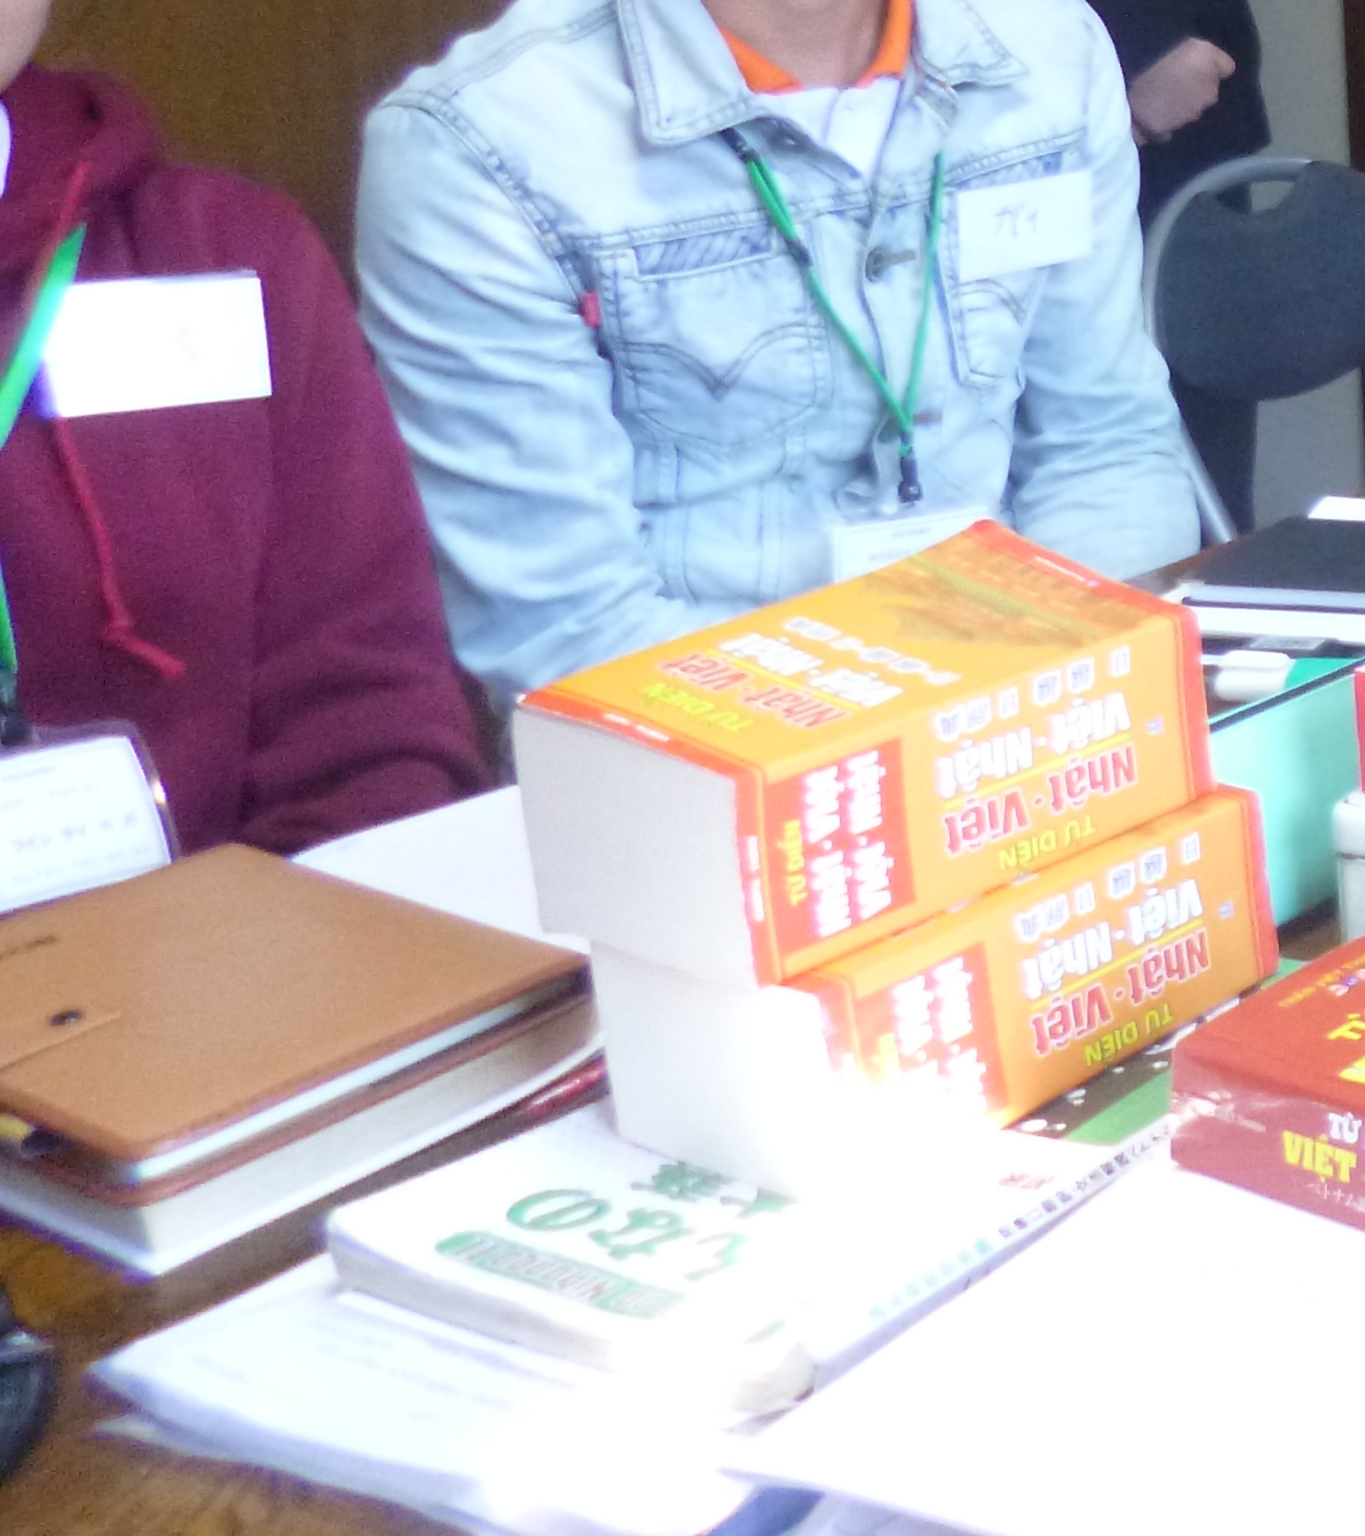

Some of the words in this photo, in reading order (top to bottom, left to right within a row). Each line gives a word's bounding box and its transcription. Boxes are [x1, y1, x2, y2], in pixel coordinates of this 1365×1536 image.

[1045, 690, 1132, 755] Việt
[934, 723, 1036, 800] Nhật
[1046, 744, 1137, 816] Nhật
[944, 789, 1032, 856] Việt
[1122, 878, 1204, 942] Việt
[1017, 914, 1115, 997] Nhật
[1122, 930, 1211, 997] Nhật
[1032, 983, 1112, 1055] Việt
[1281, 1130, 1357, 1184] VIỆT
[1327, 1111, 1362, 1142] TỪ
